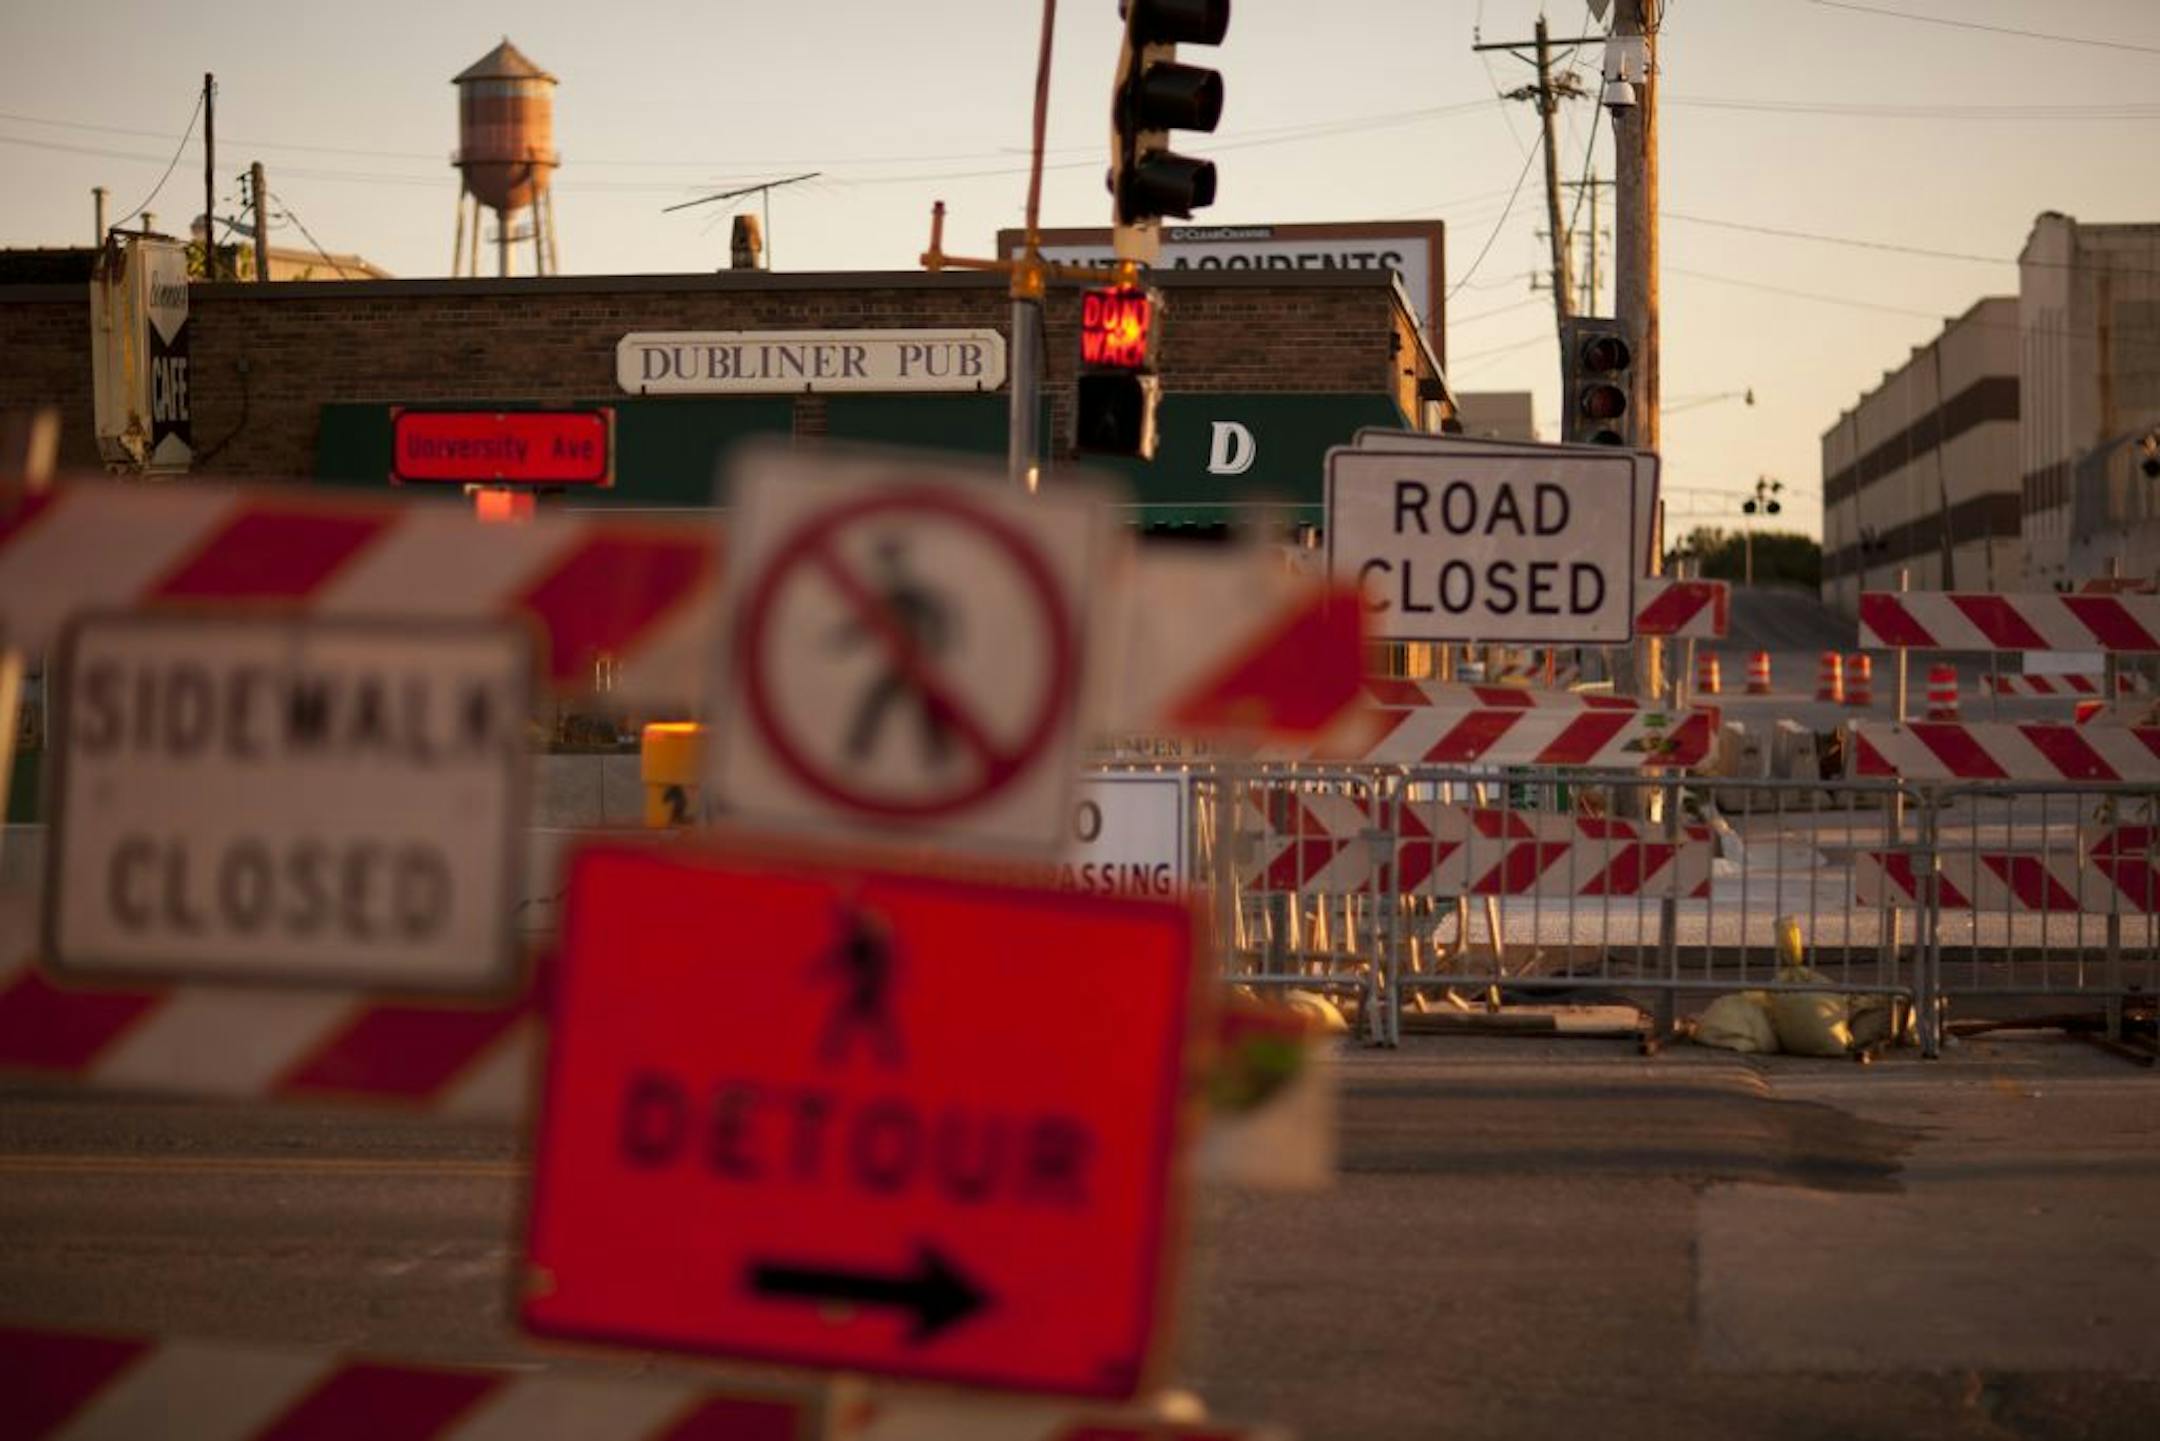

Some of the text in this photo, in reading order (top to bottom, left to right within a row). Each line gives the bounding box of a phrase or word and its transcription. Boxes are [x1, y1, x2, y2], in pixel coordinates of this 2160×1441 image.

[152, 356, 189, 422] CAFE
[641, 343, 983, 381] DUBLINER PUB
[407, 430, 594, 465] University Ave
[1206, 420, 1257, 475] D
[1393, 480, 1571, 536] ROAD
[1359, 558, 1606, 616] CLOSED
[79, 660, 497, 769] SIDEWALK
[105, 833, 455, 944] CLOSED
[616, 1065, 1099, 1211] DETOUR
